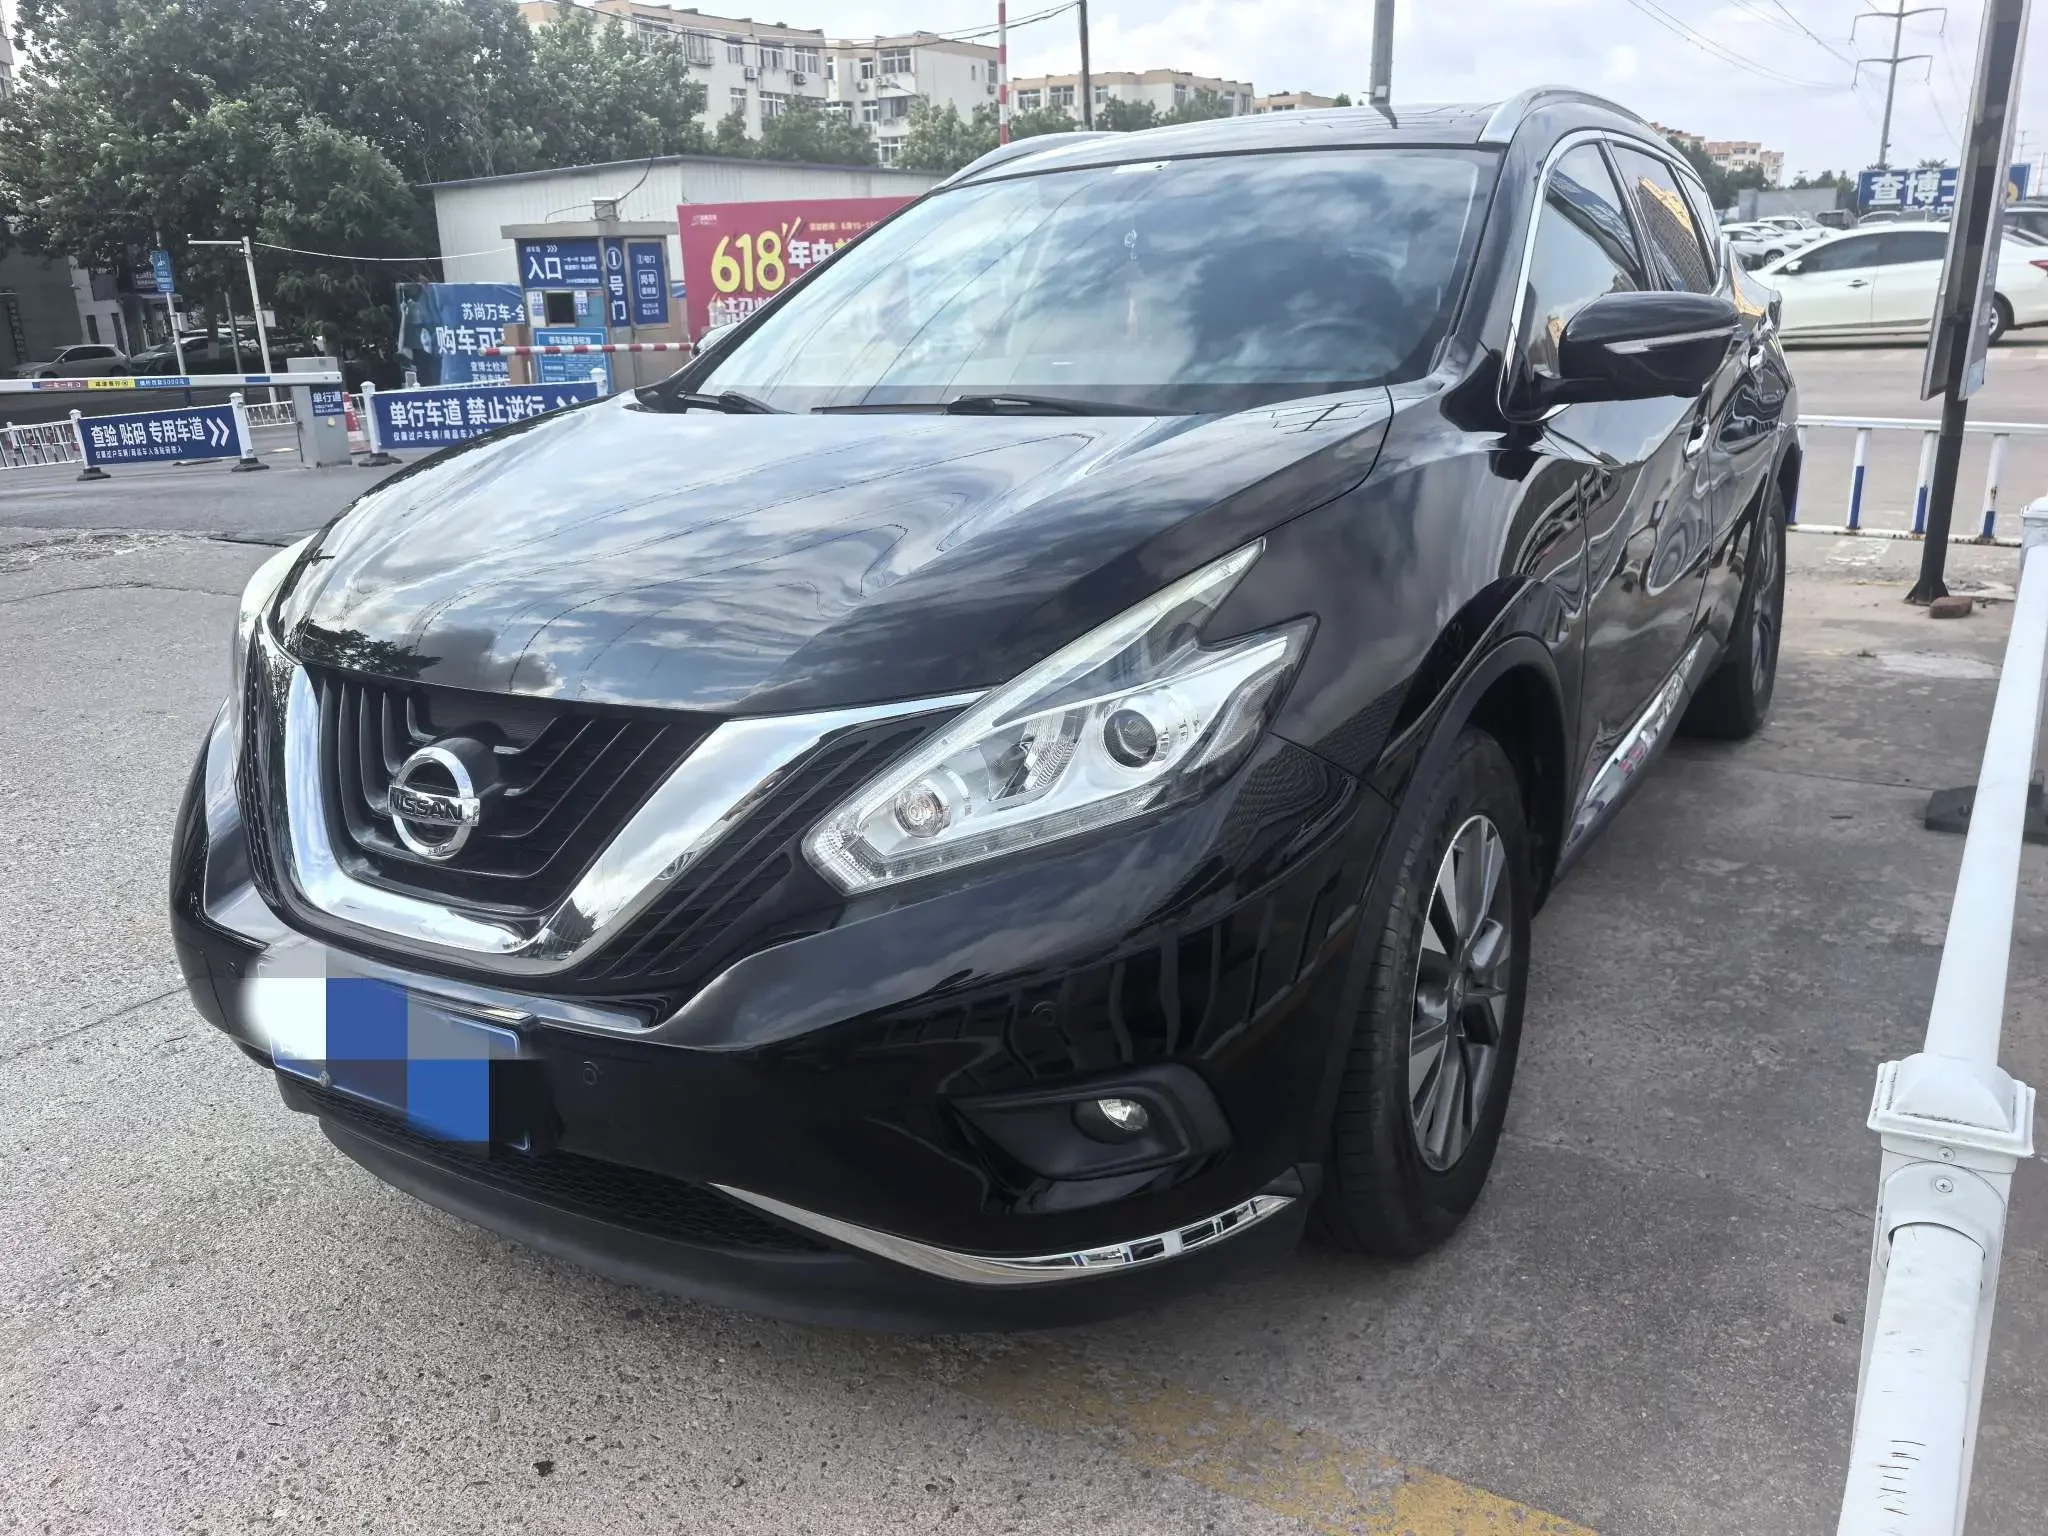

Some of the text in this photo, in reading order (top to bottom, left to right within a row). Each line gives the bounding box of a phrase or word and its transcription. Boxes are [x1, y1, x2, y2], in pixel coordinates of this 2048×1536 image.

[528, 255, 563, 280] 入口
[710, 229, 786, 294] 618
[787, 238, 852, 269] 年中
[435, 325, 506, 355] 购车可
[390, 395, 545, 428] 单行车道 禁止逆行
[119, 422, 147, 445] 贴码
[149, 416, 206, 443] 专用车道
[390, 786, 464, 822] NISSAN
